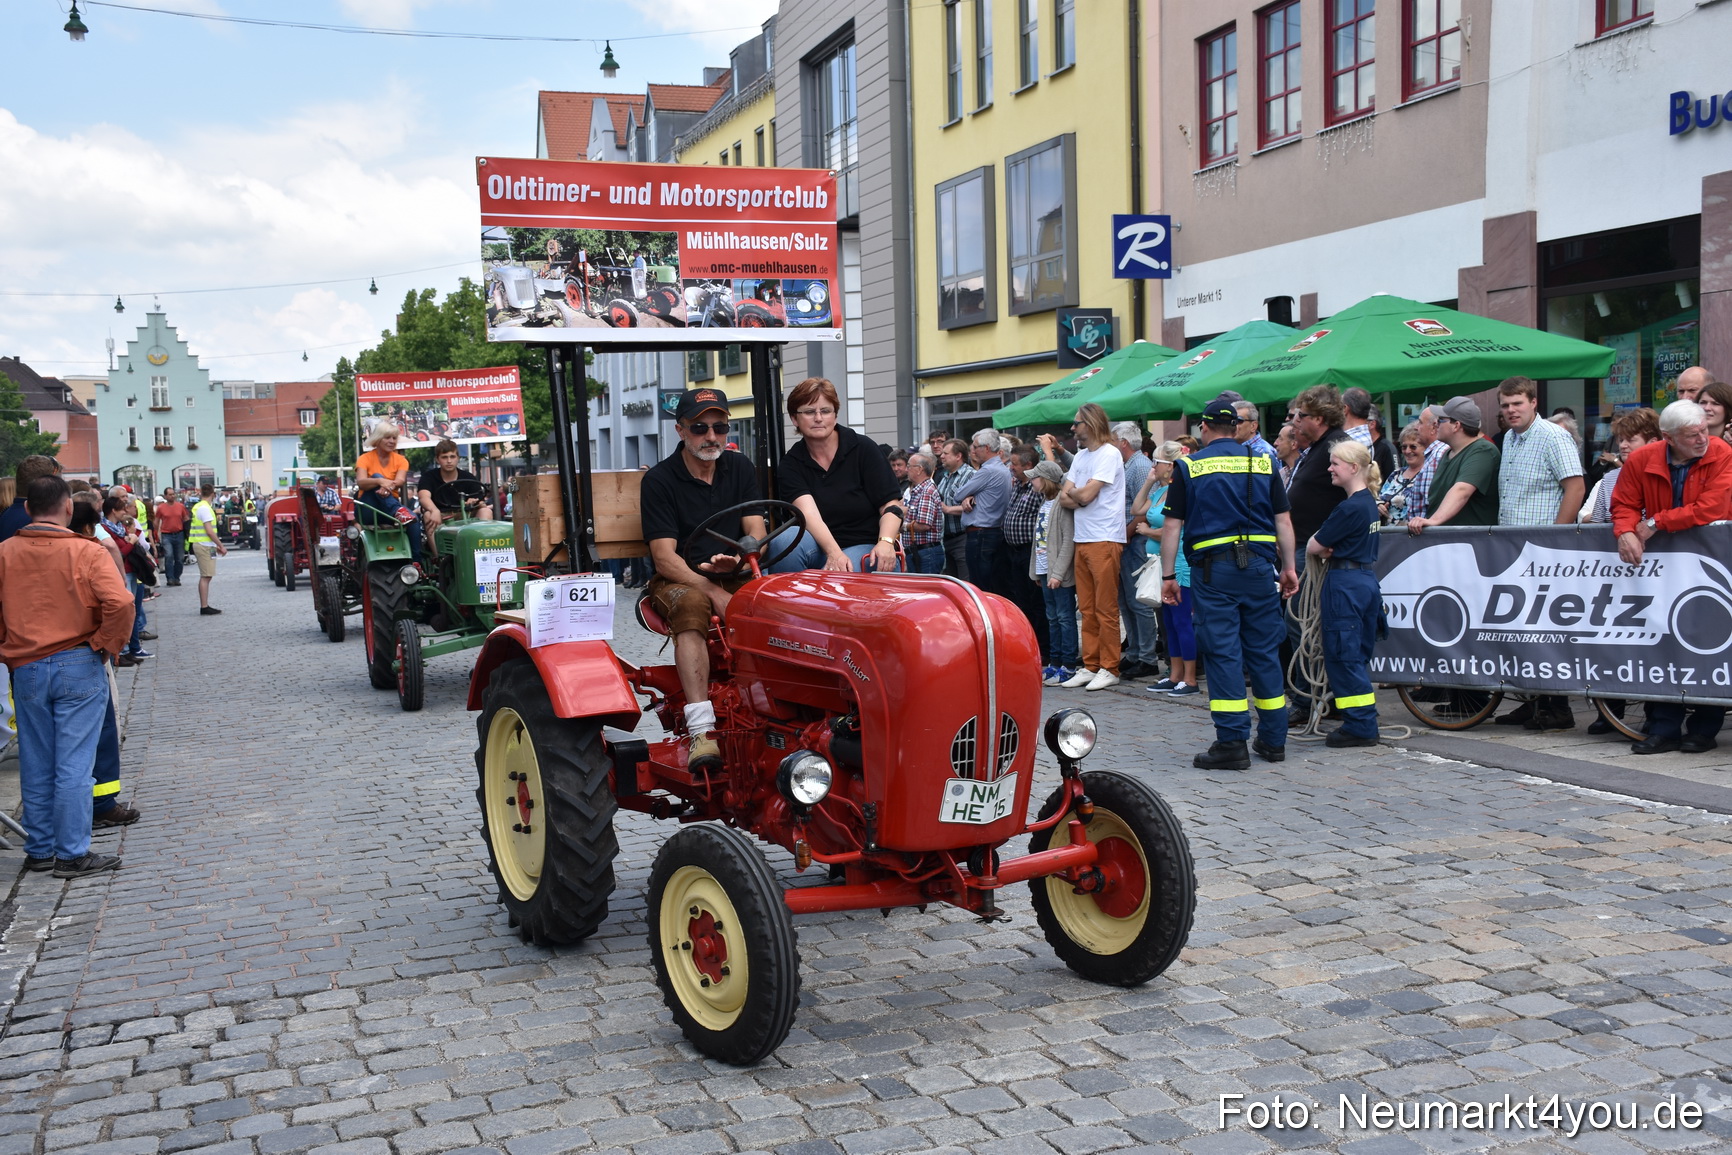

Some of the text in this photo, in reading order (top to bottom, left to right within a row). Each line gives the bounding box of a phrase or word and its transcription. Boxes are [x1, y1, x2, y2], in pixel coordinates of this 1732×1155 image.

[487, 174, 828, 212] Oldtimer- und Motorsportclub
[686, 231, 828, 252] Mühlhausen/Sulz
[688, 261, 828, 275] www.omc-muehlhausen.de
[1177, 289, 1222, 308] Unterer Markt 15
[1401, 343, 1523, 359] Lammsbräu
[1658, 352, 1690, 362] GARTEN
[1663, 362, 1686, 371] BUCH
[360, 373, 516, 392] Oldtimer- und Motorsportclub
[451, 393, 518, 406] Mühlhausen/Sulz
[478, 538, 511, 548] FENDT
[495, 556, 509, 564] 624
[1519, 558, 1664, 578] Autoklassik
[481, 594, 493, 602] EM
[569, 587, 597, 602] 621
[1481, 583, 1655, 628] Dietz
[1476, 631, 1568, 644] BREITENBRUNN
[769, 636, 800, 649] PORSCHE
[842, 649, 870, 682] Junior
[970, 783, 1001, 803] NM
[952, 798, 1006, 822] HE 15
